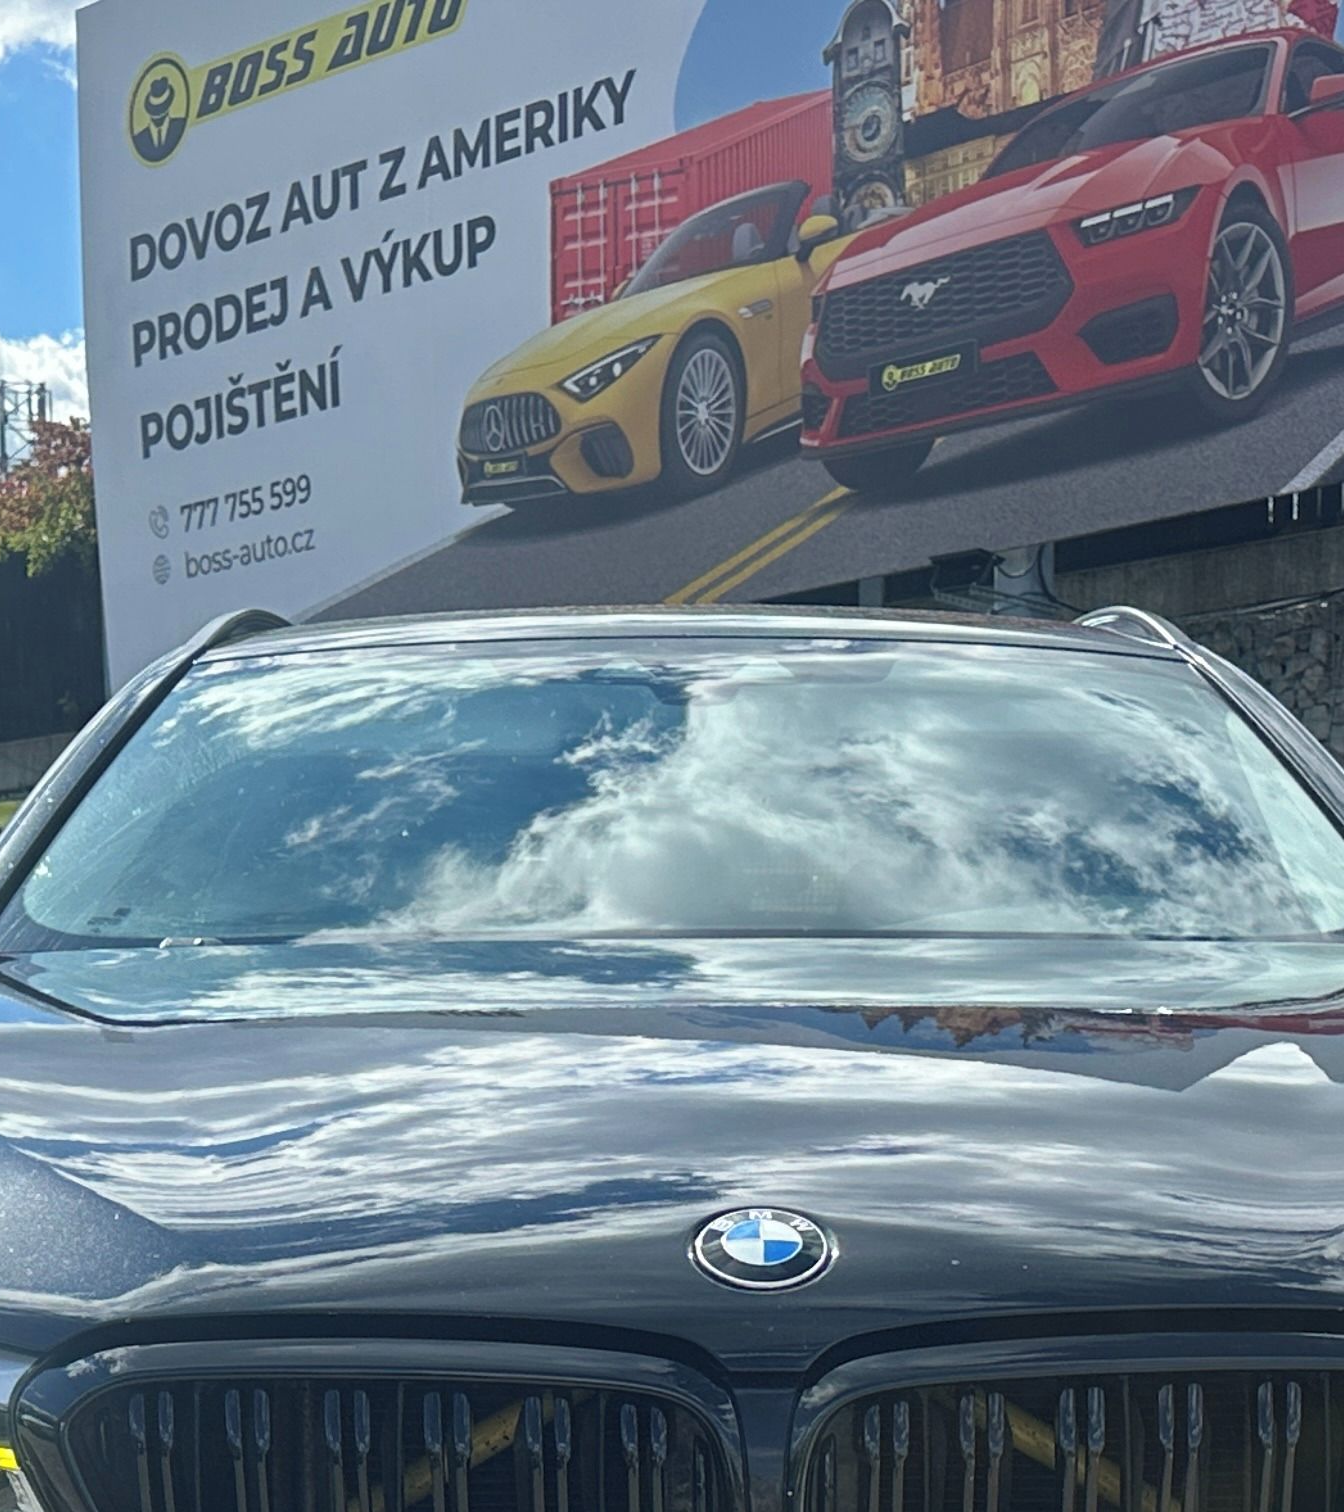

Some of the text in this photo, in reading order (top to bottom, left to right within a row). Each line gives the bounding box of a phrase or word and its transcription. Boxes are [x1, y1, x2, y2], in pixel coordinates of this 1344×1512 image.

[196, 29, 318, 119] BOSS
[129, 69, 636, 281] DOVOZ AUT Z AMERIKY
[132, 214, 497, 367] PRODEJ A VÝKUP
[140, 345, 343, 458] POJIŠTĚNÍ
[180, 474, 312, 532] 777 755 599
[184, 527, 315, 578] boss-auto.cz
[709, 1210, 815, 1232] BMW
